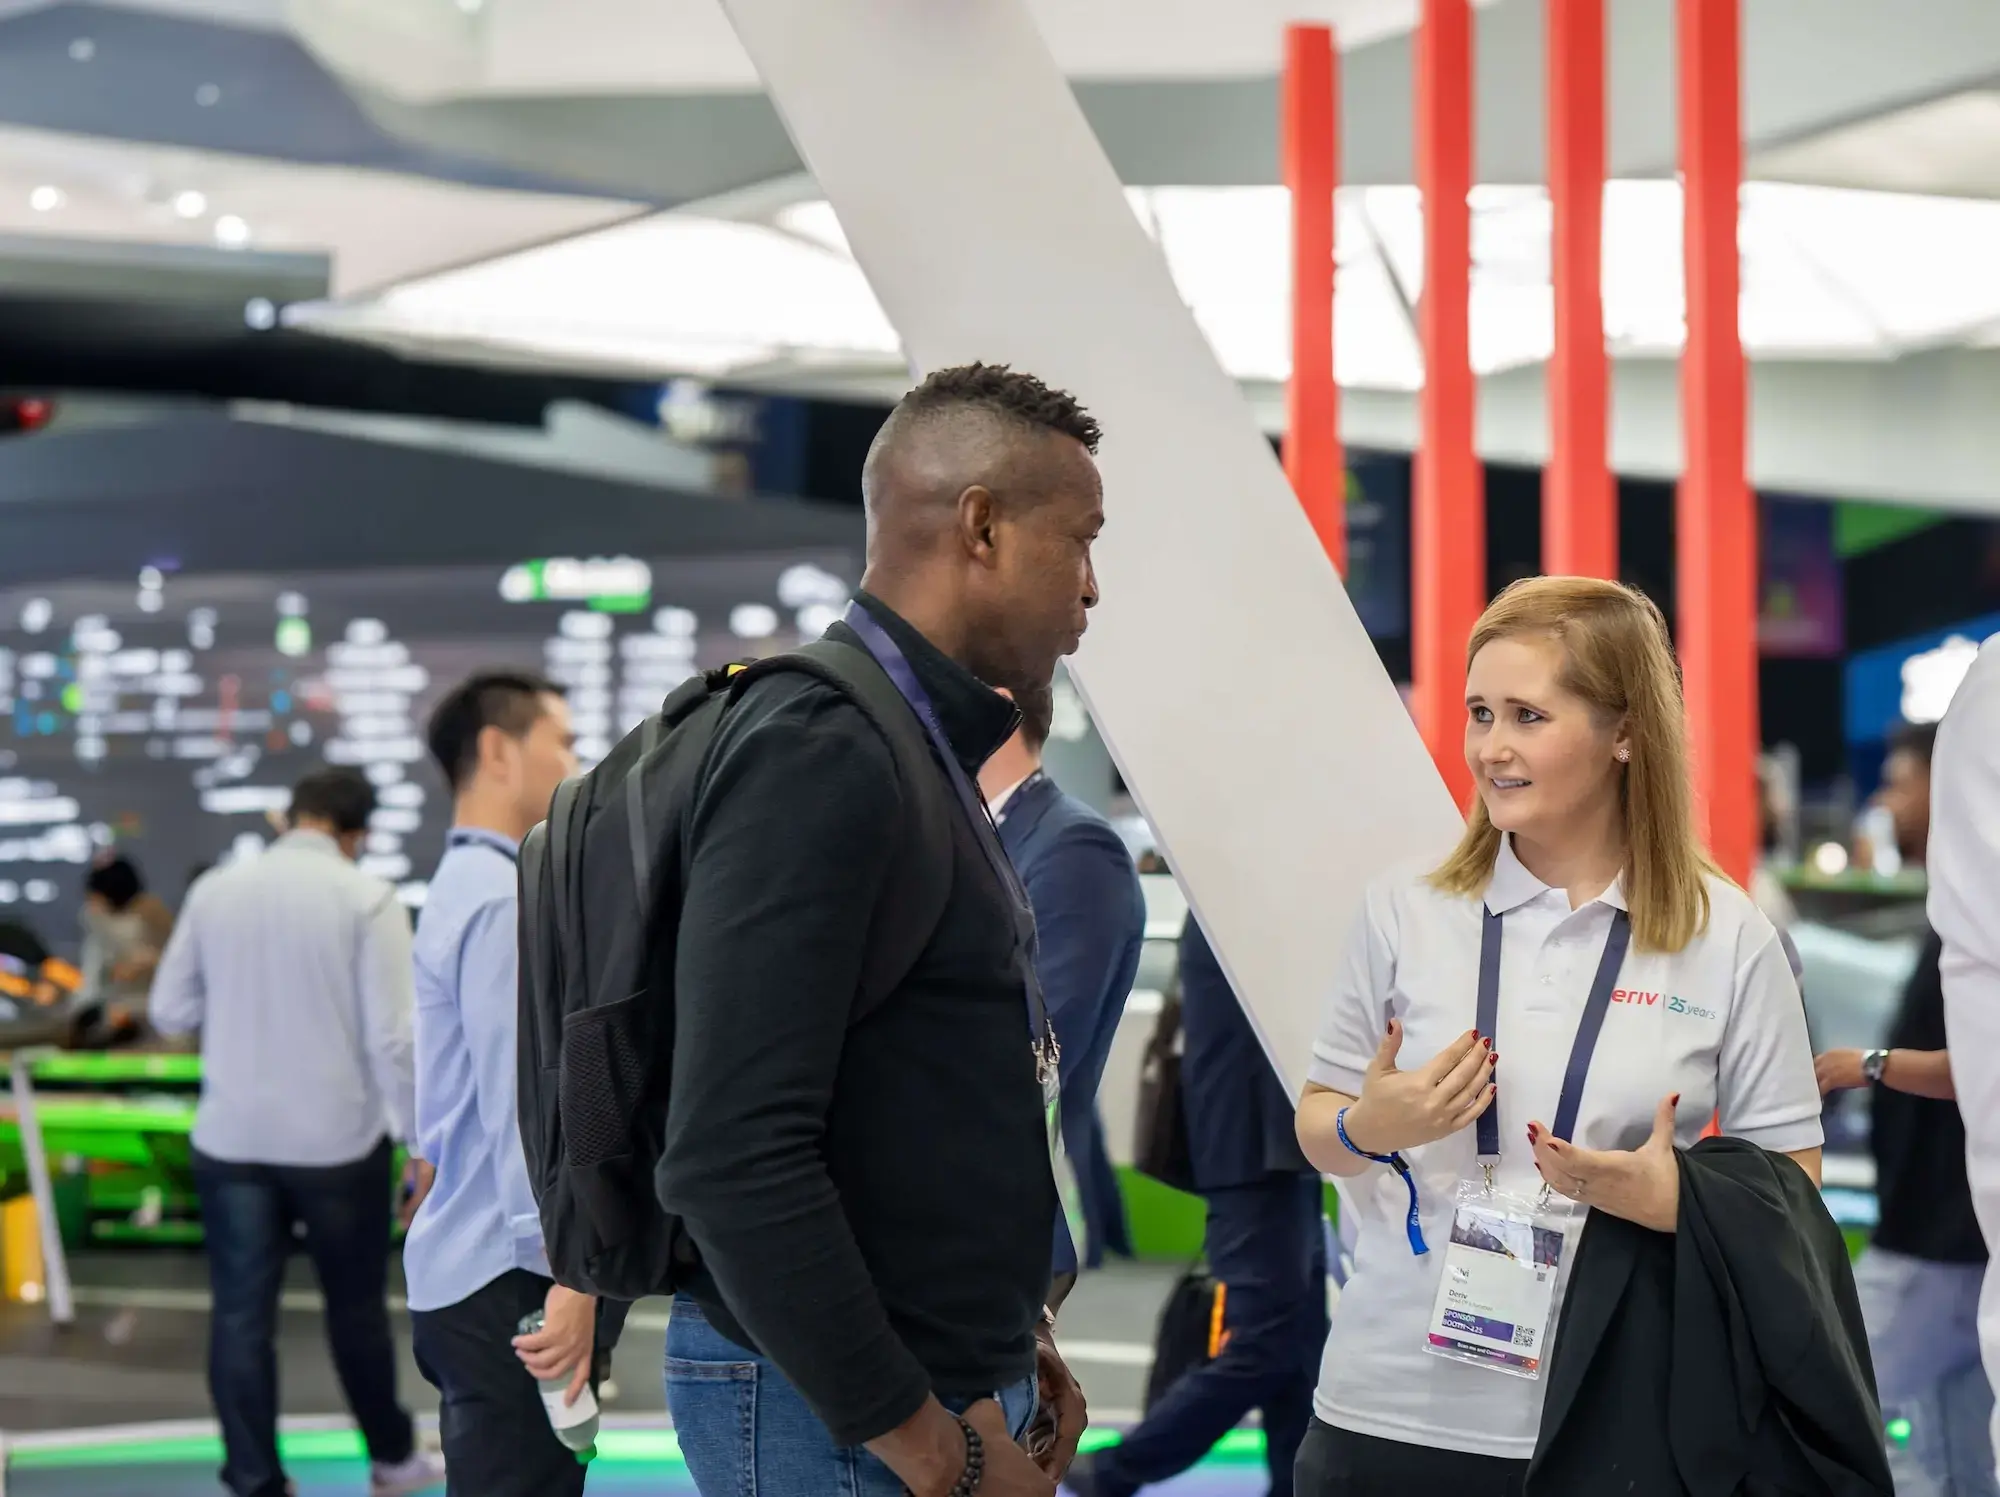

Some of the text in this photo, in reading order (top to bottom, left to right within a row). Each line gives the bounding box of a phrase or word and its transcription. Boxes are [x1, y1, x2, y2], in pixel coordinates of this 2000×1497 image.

[1611, 988, 1717, 1020] eriv 25 years
[1449, 1289, 1468, 1299] Deriv
[1444, 1309, 1476, 1323] SPONSOR
[1442, 1318, 1466, 1330] BOOTH
[1486, 1349, 1506, 1359] Connect
